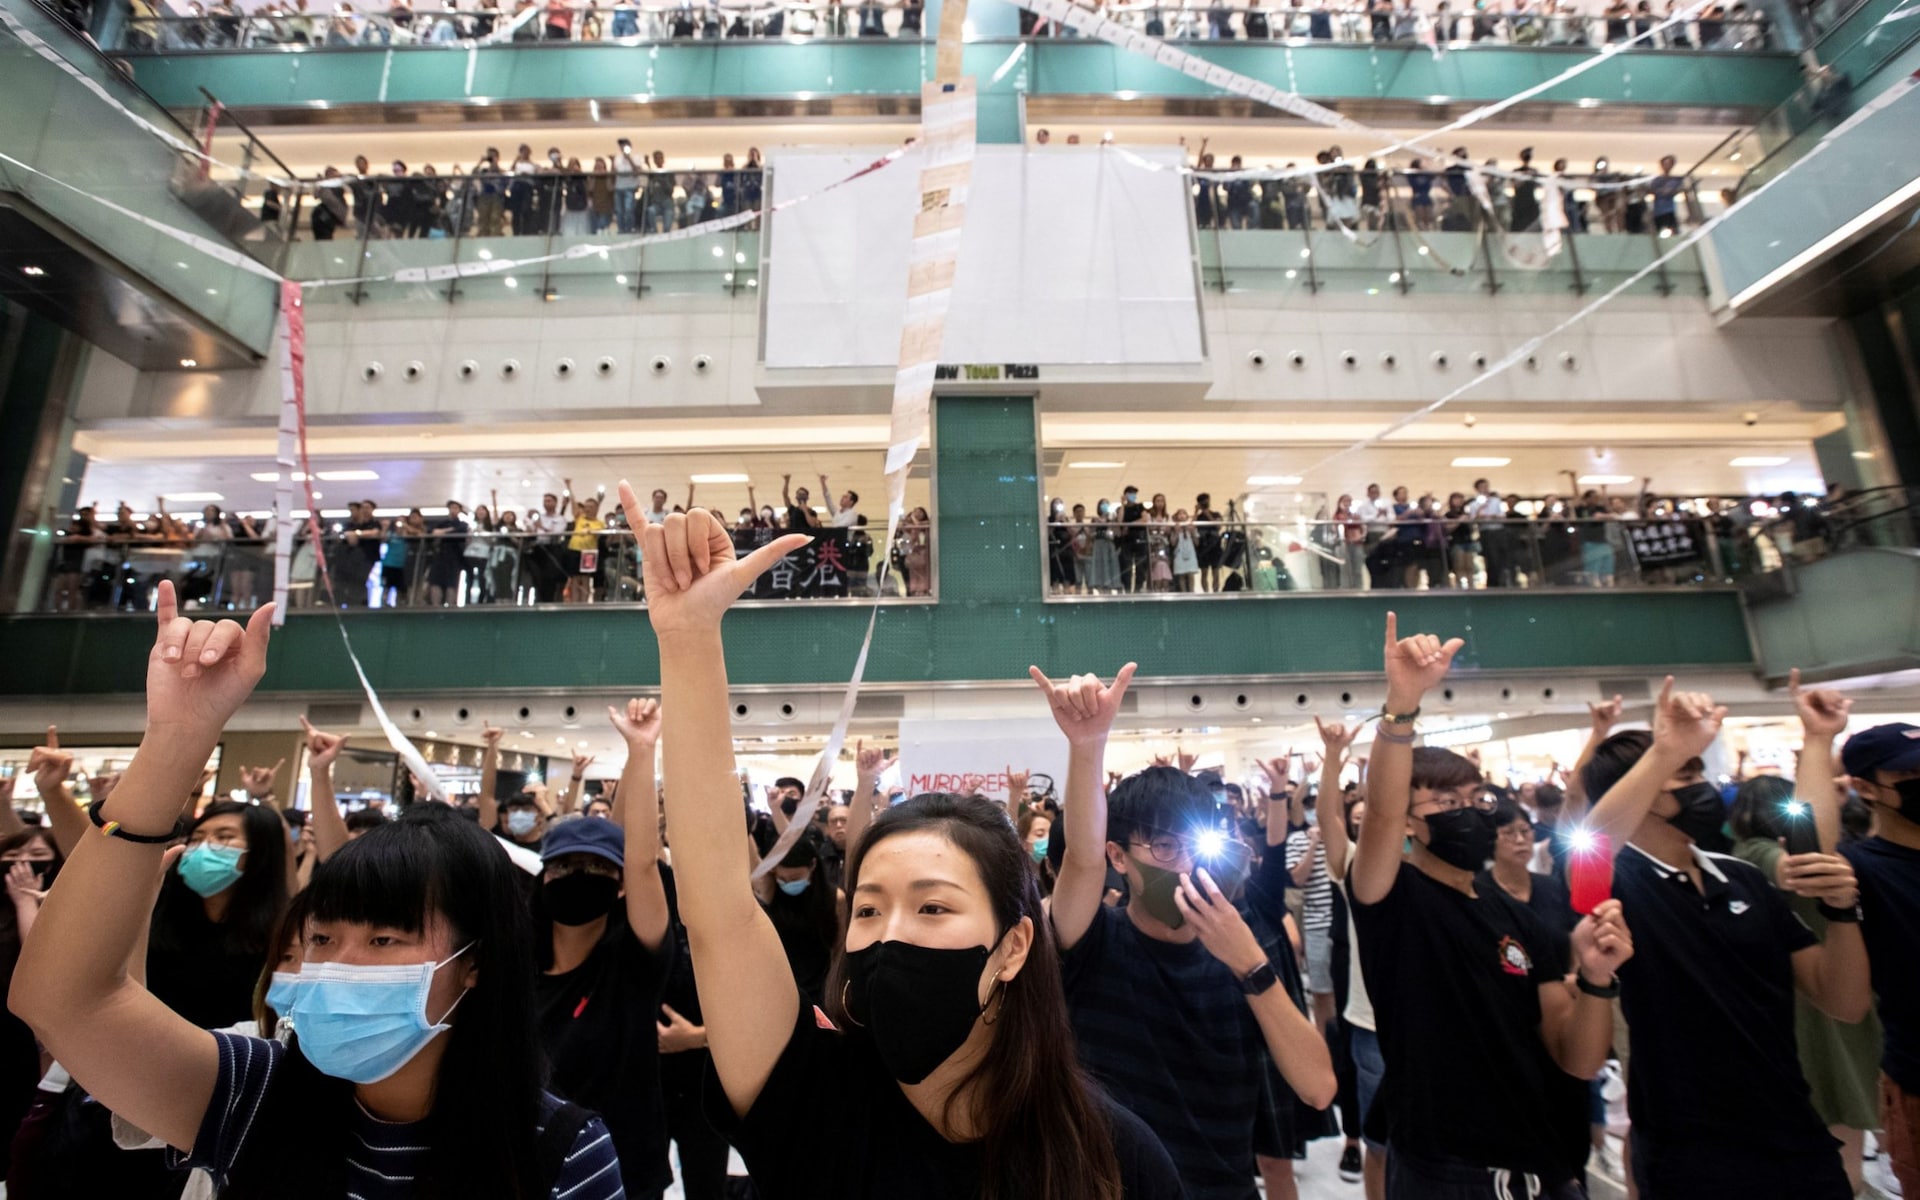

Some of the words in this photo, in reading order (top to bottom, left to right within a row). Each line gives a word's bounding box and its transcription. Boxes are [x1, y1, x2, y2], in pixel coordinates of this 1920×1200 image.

[964, 364, 999, 380] Town
[1005, 364, 1039, 379] Plaza
[744, 537, 847, 596] 香港
